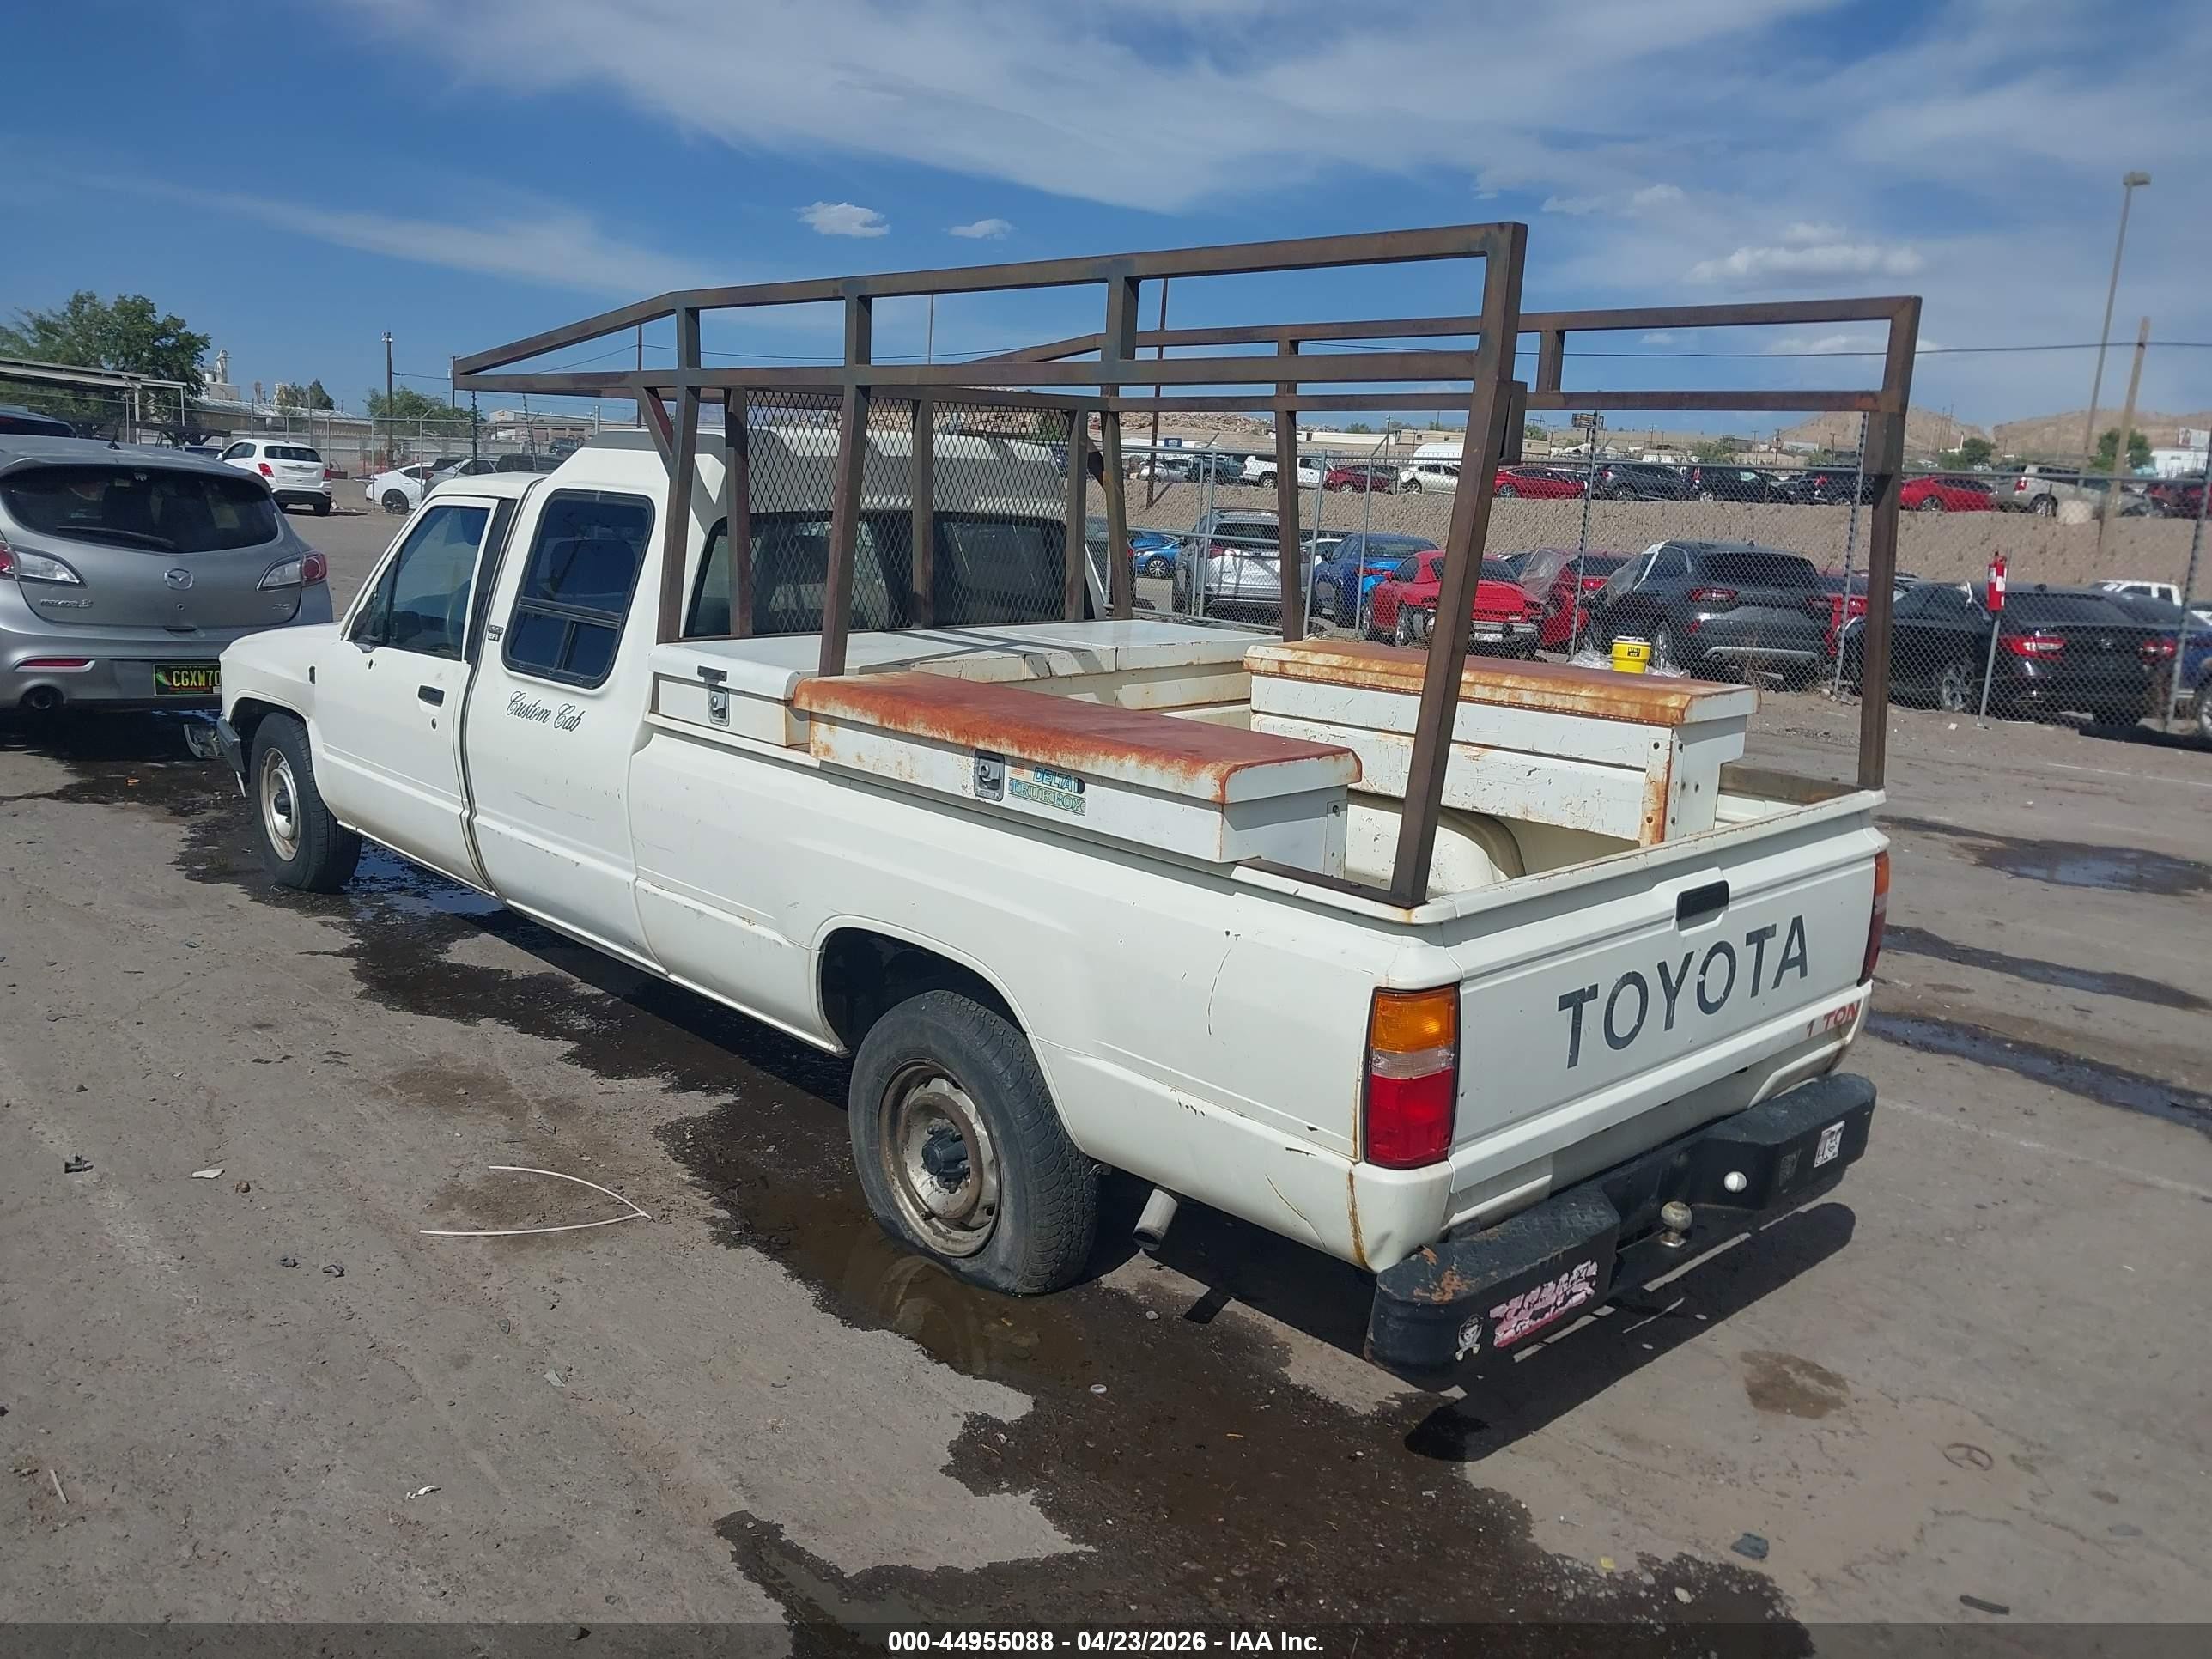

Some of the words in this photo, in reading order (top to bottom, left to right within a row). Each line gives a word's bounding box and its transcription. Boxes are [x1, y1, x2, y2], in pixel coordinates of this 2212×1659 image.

[506, 690, 552, 724] Custom
[553, 703, 586, 732] Cab
[1558, 915, 1808, 1069] TOYOTA
[1807, 1018, 1815, 1037] 1
[1824, 999, 1861, 1030] TON
